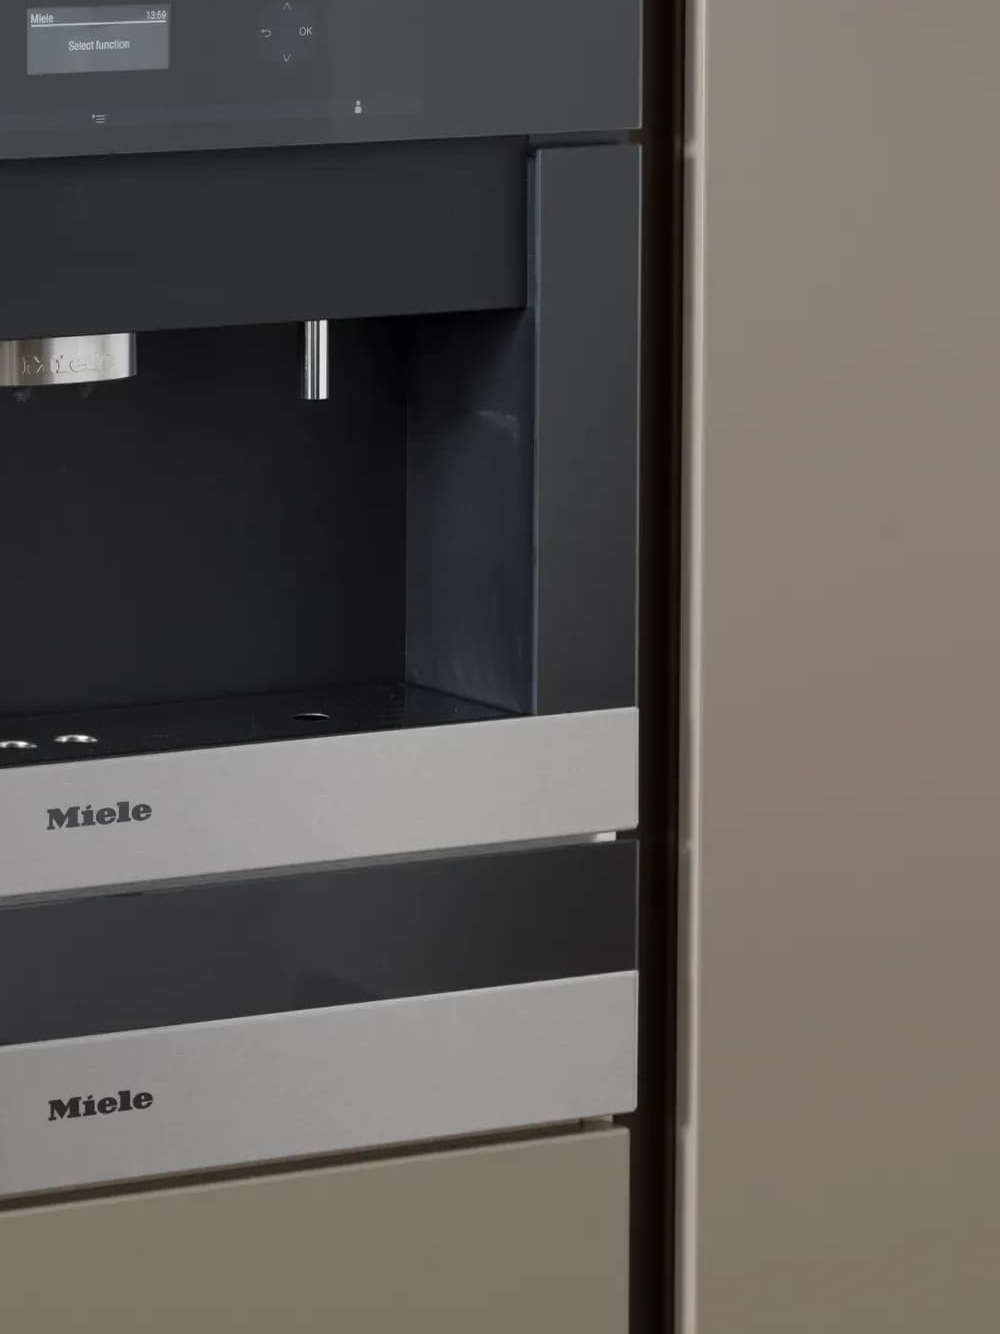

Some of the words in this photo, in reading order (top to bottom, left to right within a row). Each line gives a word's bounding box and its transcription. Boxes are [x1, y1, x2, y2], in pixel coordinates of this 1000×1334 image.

[30, 13, 55, 24] Miele
[298, 26, 313, 36] OK
[68, 40, 94, 51] Select
[95, 39, 131, 50] function
[46, 801, 153, 831] Miele
[48, 1089, 154, 1122] Miele
